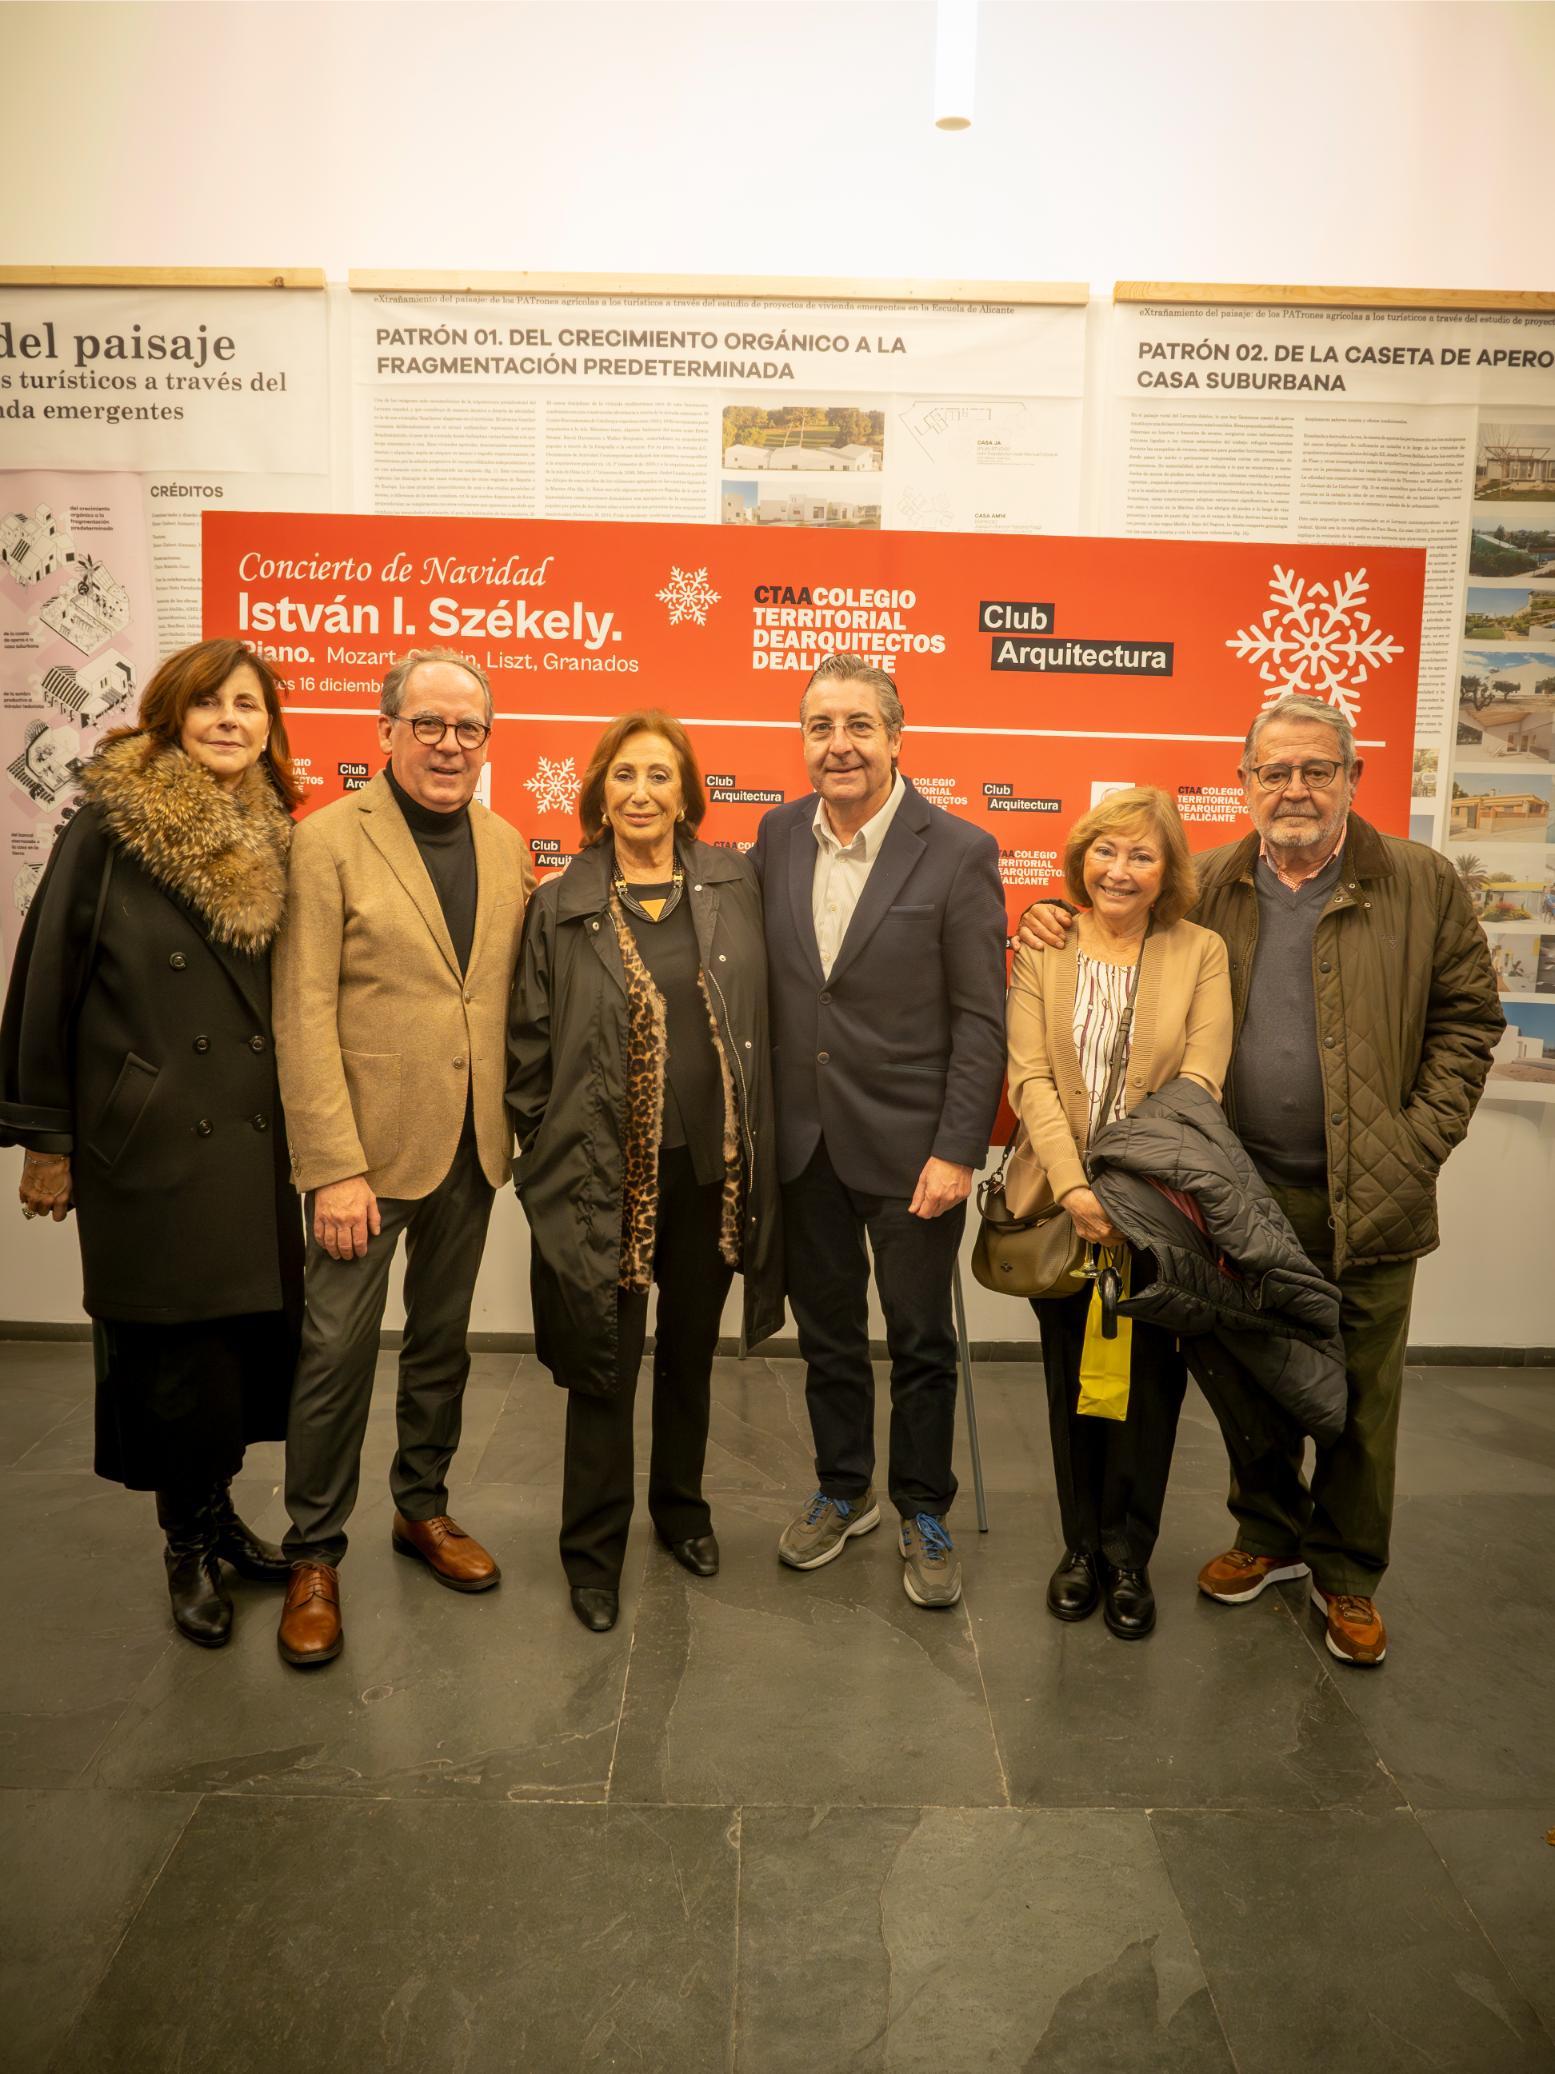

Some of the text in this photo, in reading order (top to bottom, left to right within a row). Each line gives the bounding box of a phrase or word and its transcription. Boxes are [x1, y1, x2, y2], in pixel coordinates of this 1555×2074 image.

[440, 294, 453, 303] del
[490, 295, 500, 304] de
[502, 296, 514, 305] los
[609, 297, 621, 306] los
[702, 299, 715, 308] del
[718, 299, 749, 309] estudio
[751, 300, 761, 309] de
[806, 301, 816, 310] de
[818, 301, 854, 310] vivienda
[921, 303, 930, 312] la
[967, 304, 977, 313] de
[979, 304, 1015, 314] Alicante
[1139, 307, 1203, 318] eXtrañamiento
[1205, 308, 1218, 318] del
[1256, 309, 1266, 318] de
[1268, 310, 1280, 319] los
[1283, 309, 1324, 320] PATrones
[1326, 311, 1363, 322] agrícolas
[1373, 311, 1386, 321] los
[1388, 312, 1427, 322] turísticos
[1437, 313, 1462, 323] través
[1465, 313, 1477, 323] del
[1480, 313, 1510, 324] estudio
[1512, 316, 1522, 325] de
[74, 323, 237, 368] paisaje
[377, 325, 906, 353] PATRÓN 01. DEL CRECIMIENTO ORGÁNICO A LA
[1138, 338, 1554, 368] PATRÓN 02. DE LA CASETA DE APERO
[377, 354, 794, 379] FRAGMENTACIÓN PREDETERMINADA
[19, 370, 137, 392] turísticos
[145, 377, 158, 391] a
[166, 373, 242, 393] través
[250, 373, 287, 393] del
[1137, 370, 1347, 392] CASA SUBURBANA
[43, 402, 185, 424] emergentes
[150, 484, 224, 499] CRÉDITOS
[238, 551, 555, 587] Concierto de Navidad
[238, 592, 623, 650] István I. Székely.
[752, 607, 908, 631] TERRITORIAL
[983, 604, 1048, 631] Club
[752, 630, 948, 654] DEARQUITECTOS
[487, 651, 538, 672] Liszt,
[543, 653, 639, 673] Granados
[752, 650, 897, 674] DEALITE
[997, 640, 1168, 672] Arquitectura
[300, 677, 315, 691] 16
[319, 678, 385, 693] diciemb
[339, 764, 367, 776] Club
[706, 776, 733, 787] Club
[912, 777, 956, 787] COLEGIO
[984, 784, 1011, 796] Club
[713, 789, 782, 803] Arquitectura
[990, 798, 1059, 812] Arquitectura
[1178, 795, 1240, 805] TERRITORIAL
[1177, 804, 1249, 814] DEARQUITECTO
[532, 840, 559, 851] Club
